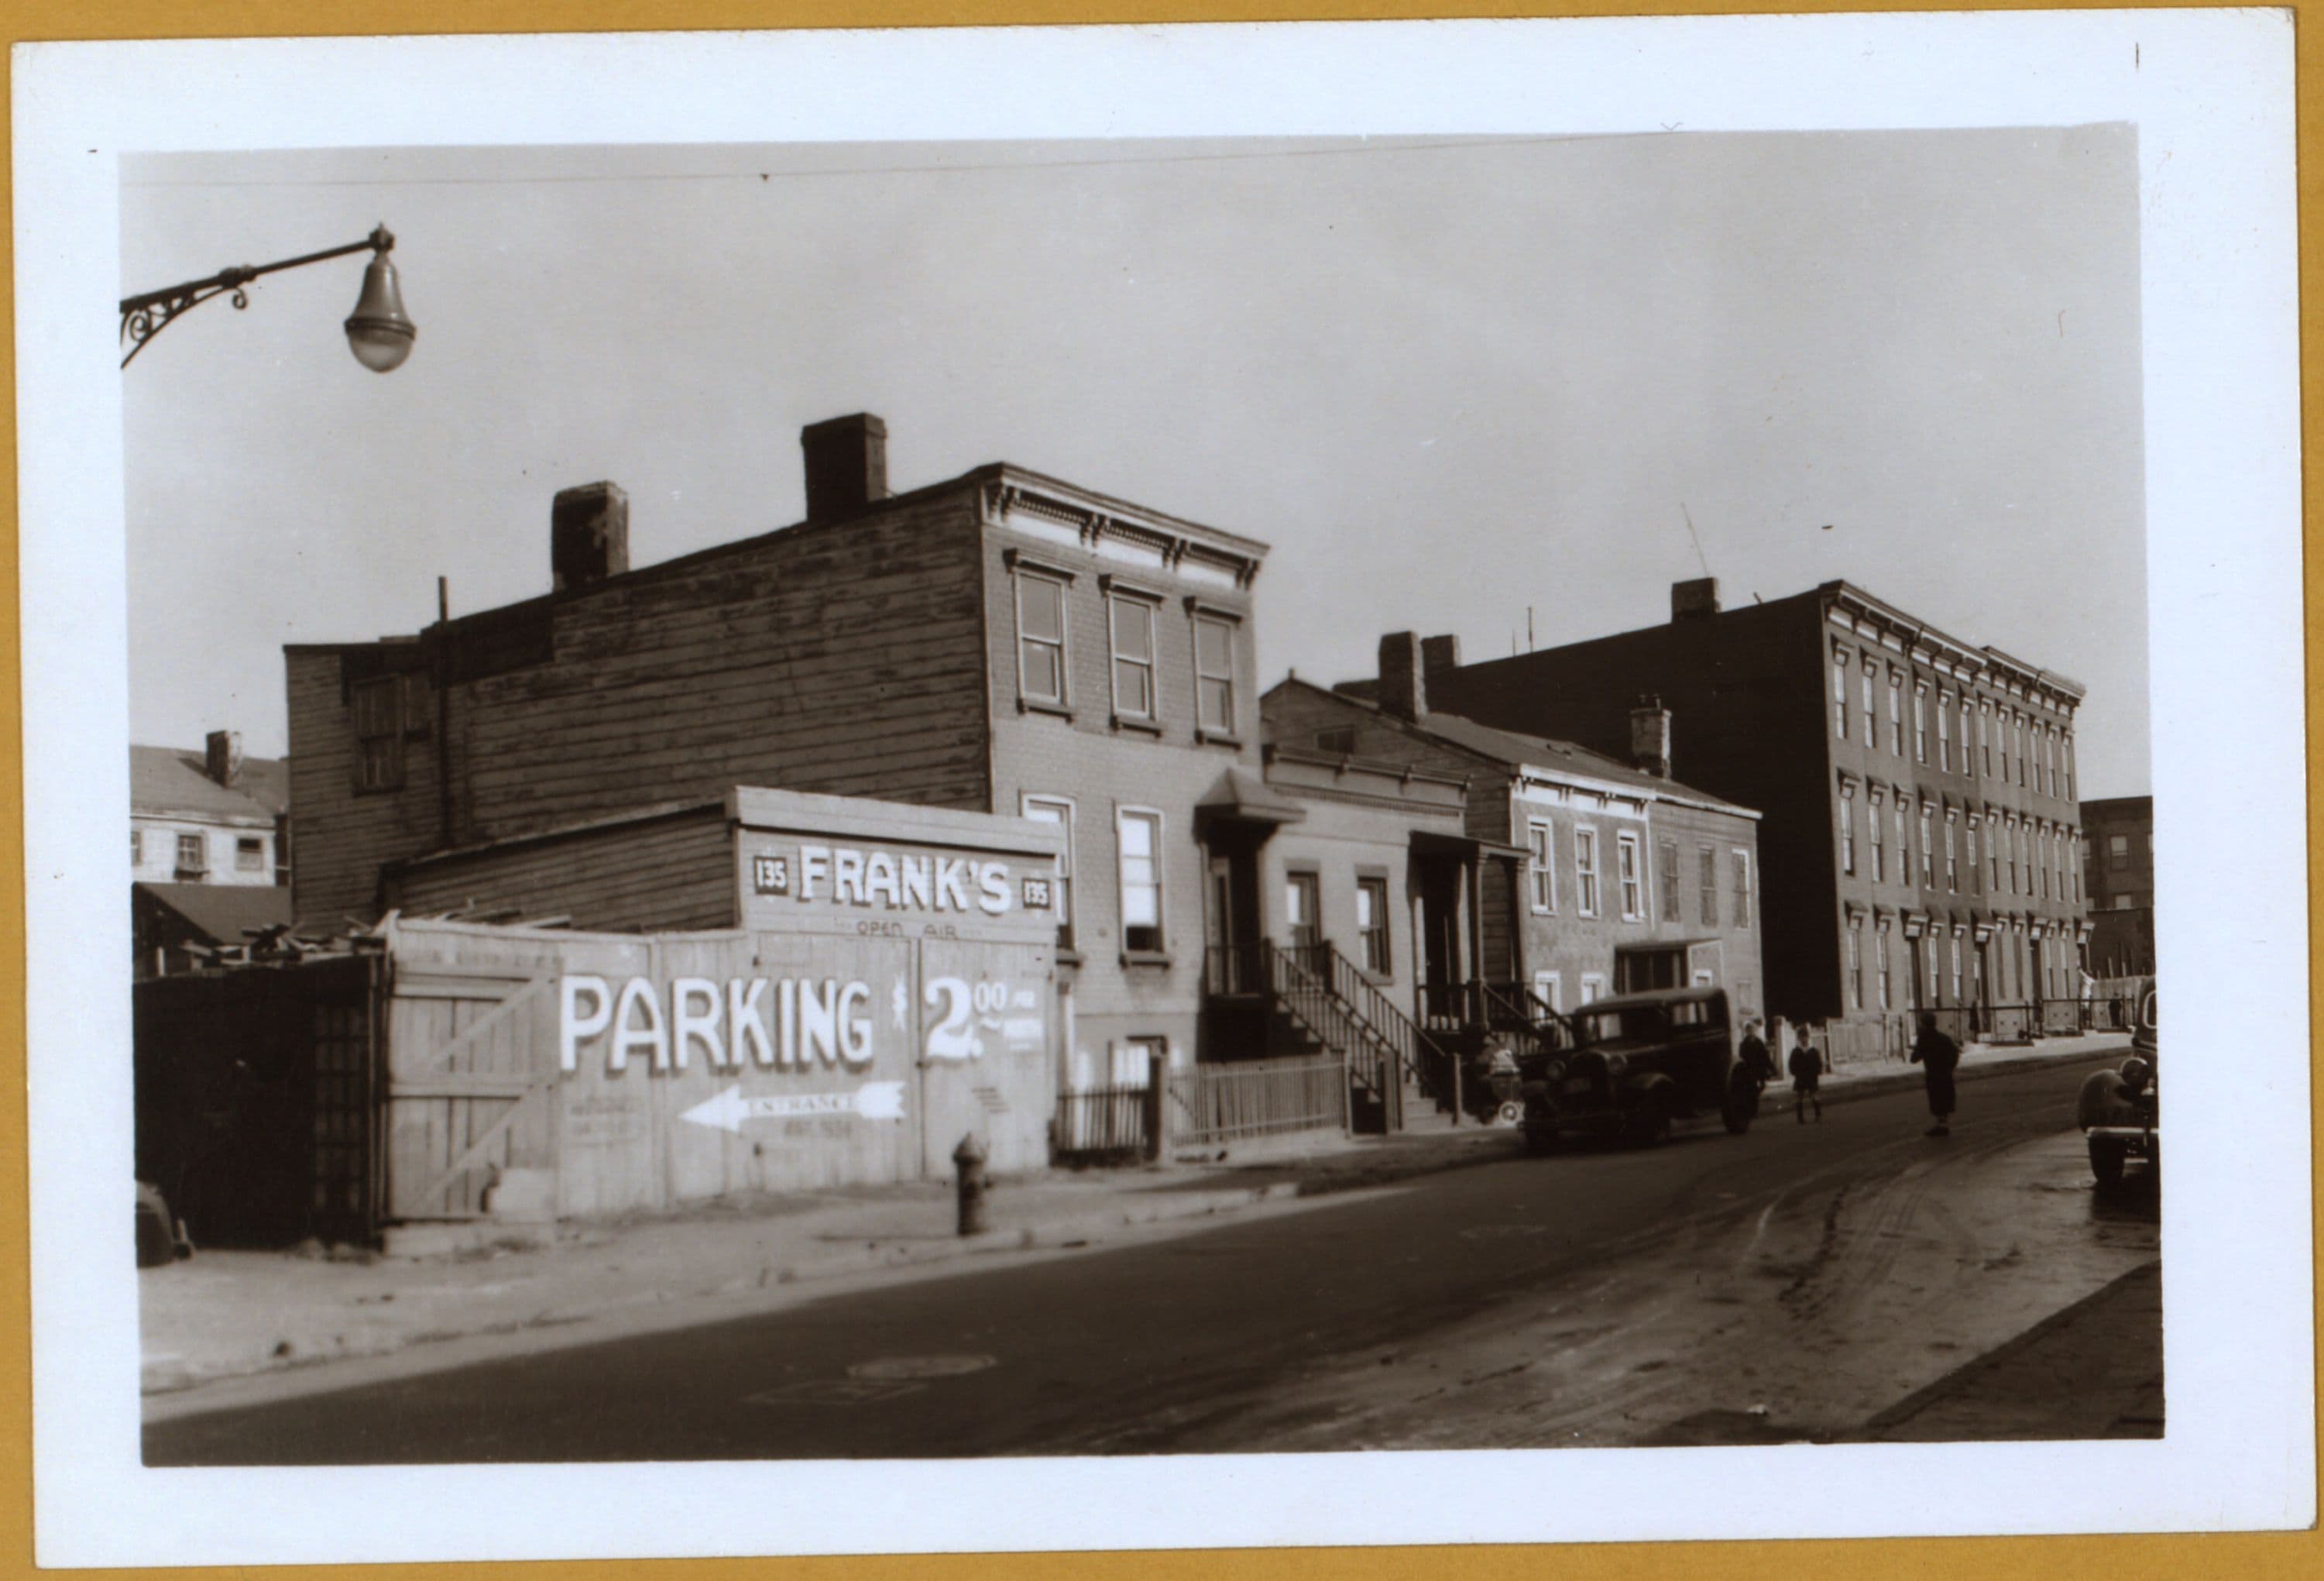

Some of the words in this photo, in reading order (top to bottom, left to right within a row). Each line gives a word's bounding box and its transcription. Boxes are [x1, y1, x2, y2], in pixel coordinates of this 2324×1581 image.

[799, 845, 1013, 915] FRANK'S
[856, 919, 905, 937] OPEN
[923, 923, 958, 940] AIR
[559, 975, 874, 1071] PARKING
